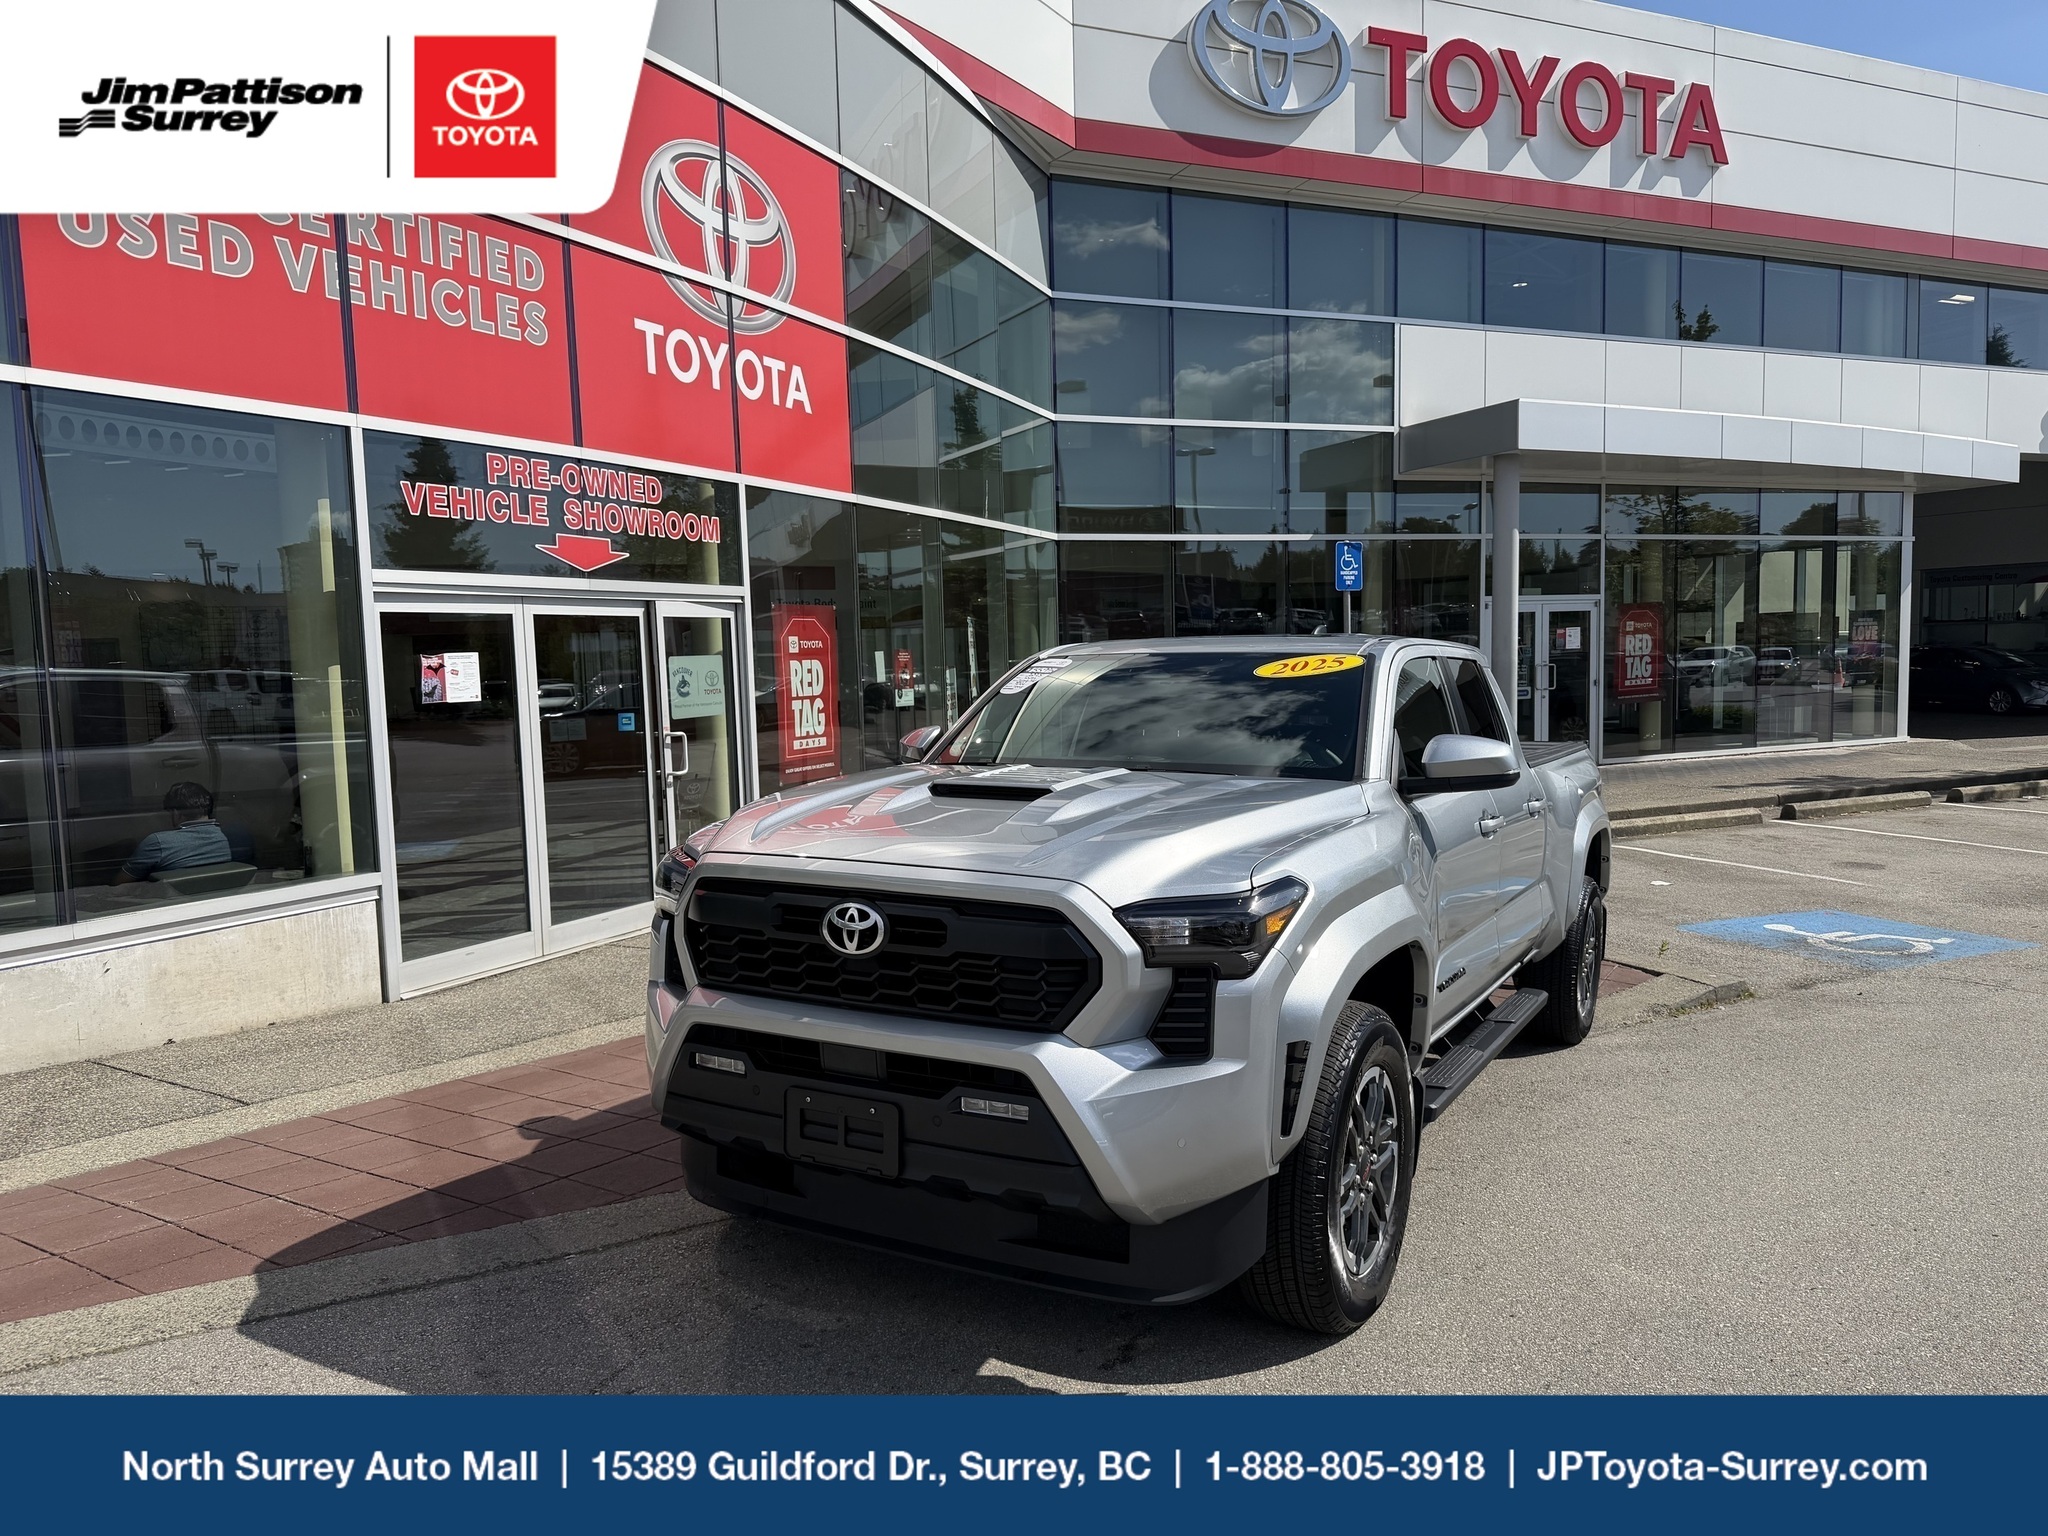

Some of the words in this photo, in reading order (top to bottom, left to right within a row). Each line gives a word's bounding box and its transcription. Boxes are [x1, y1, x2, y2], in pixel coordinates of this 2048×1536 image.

[1363, 26, 1729, 167] TOYOTA
[57, 213, 255, 280] USED
[273, 235, 549, 347] VEHICLES
[634, 317, 813, 415] TOYOTA
[486, 452, 663, 506] PRE-OWNED
[400, 480, 549, 526] VEHICLE
[563, 498, 721, 543] SHOWROOM
[800, 640, 823, 649] TOYOTA
[1625, 633, 1652, 656] RED
[1852, 626, 1878, 641] LOVE
[790, 659, 824, 697] RED
[1270, 656, 1347, 676] 2025
[1625, 656, 1652, 679] TAG
[792, 698, 826, 737] TAG
[799, 738, 822, 748] DAYS
